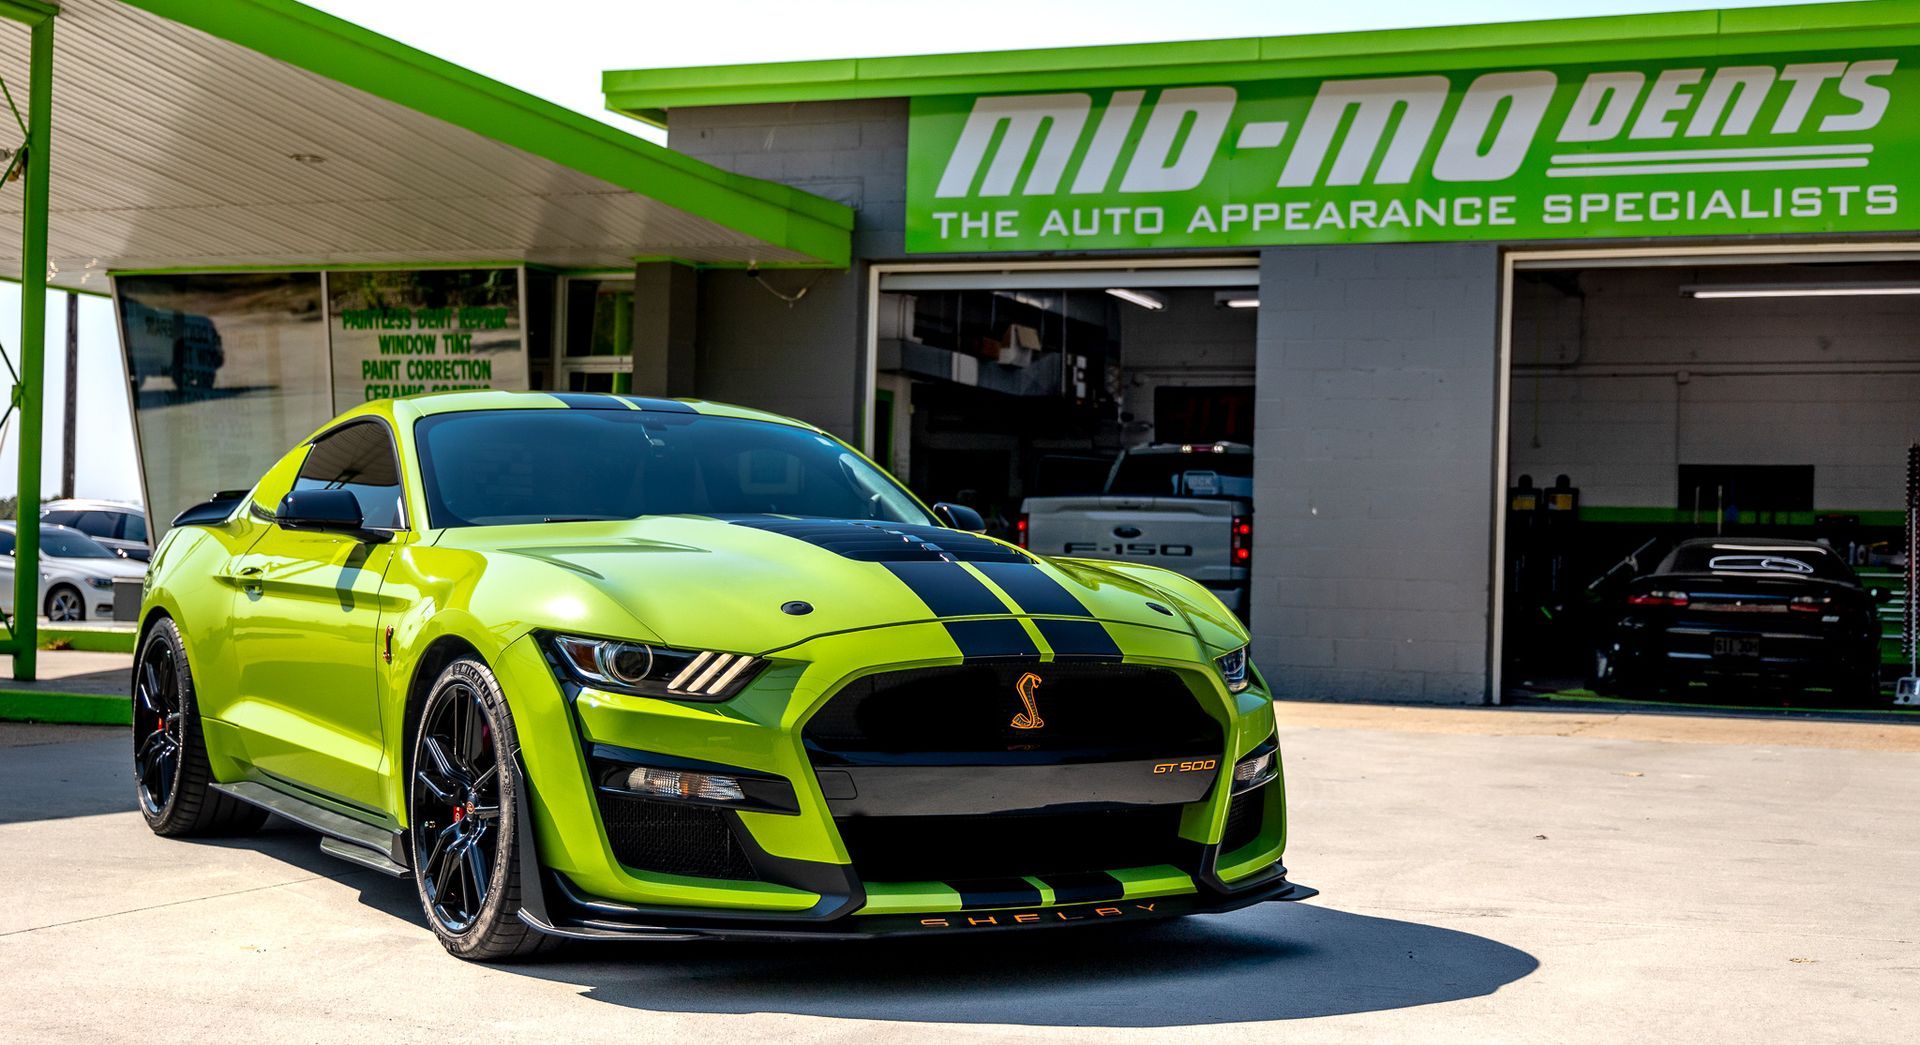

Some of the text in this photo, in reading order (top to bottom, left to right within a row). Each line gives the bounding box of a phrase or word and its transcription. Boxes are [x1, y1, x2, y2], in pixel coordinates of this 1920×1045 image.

[935, 59, 1899, 198] MID-MO DENTS
[932, 184, 1898, 239] THE AUTO APPEARANCE SPECIALISTS
[342, 307, 508, 329] PAINTLESS DENT REPAIR
[378, 334, 473, 355] WINDOW TINT
[362, 360, 492, 380] PAINT CORRECTION
[1063, 542, 1193, 557] F-150
[460, 664, 493, 706] MICHELIN
[1153, 760, 1216, 773] GT 500
[920, 903, 1155, 928] SHELBY
